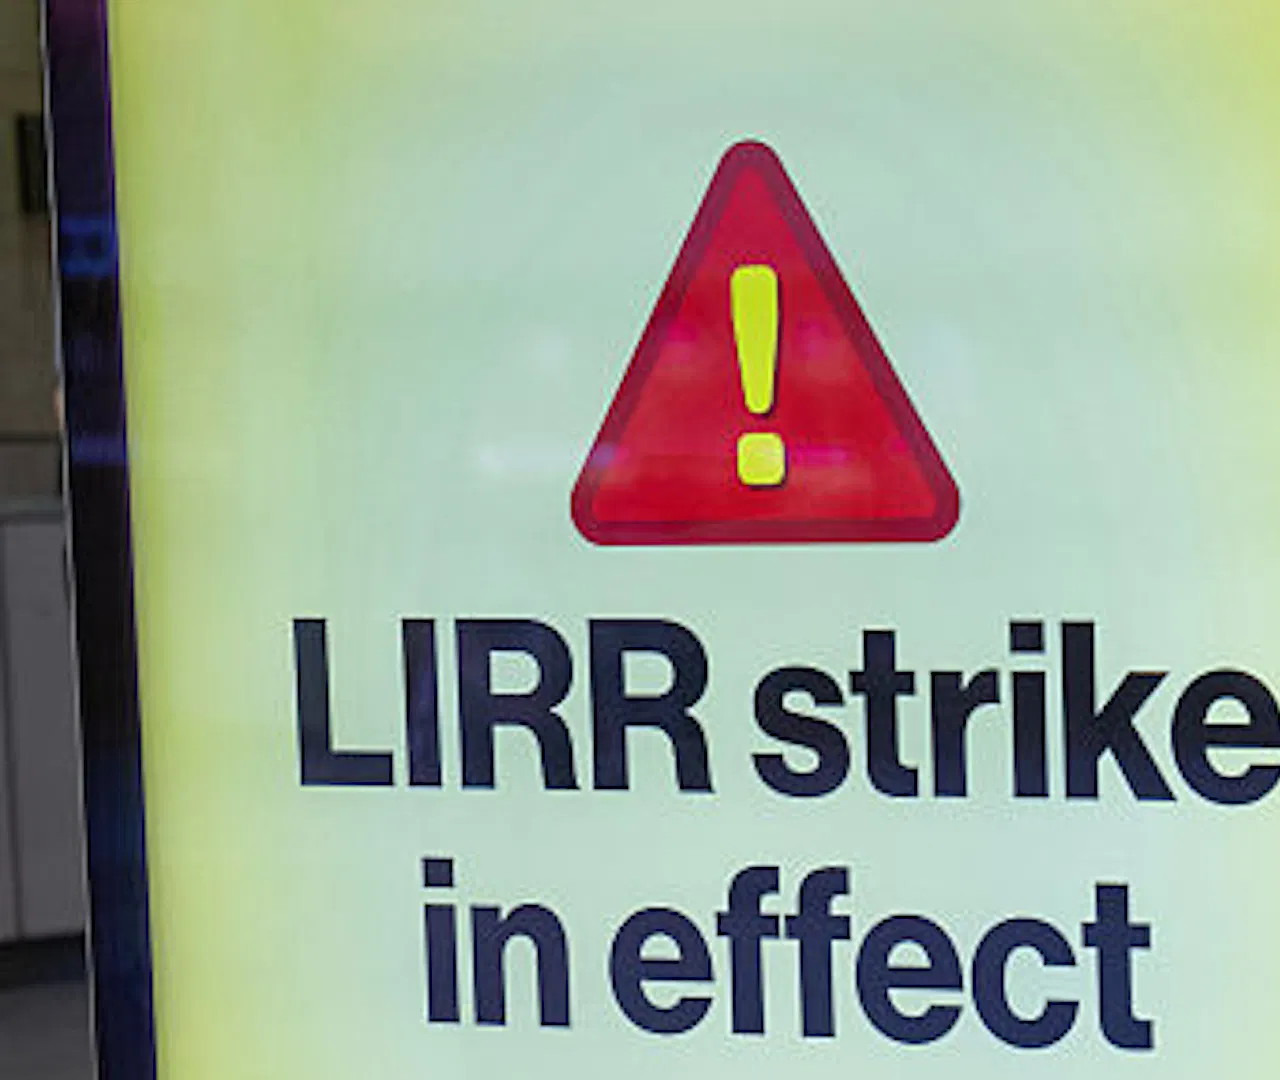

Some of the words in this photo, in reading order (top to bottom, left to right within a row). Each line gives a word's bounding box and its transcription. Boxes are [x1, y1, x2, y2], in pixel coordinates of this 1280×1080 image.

[292, 617, 715, 794] LIRR
[421, 856, 571, 1029] in
[608, 865, 1155, 1051] effect
